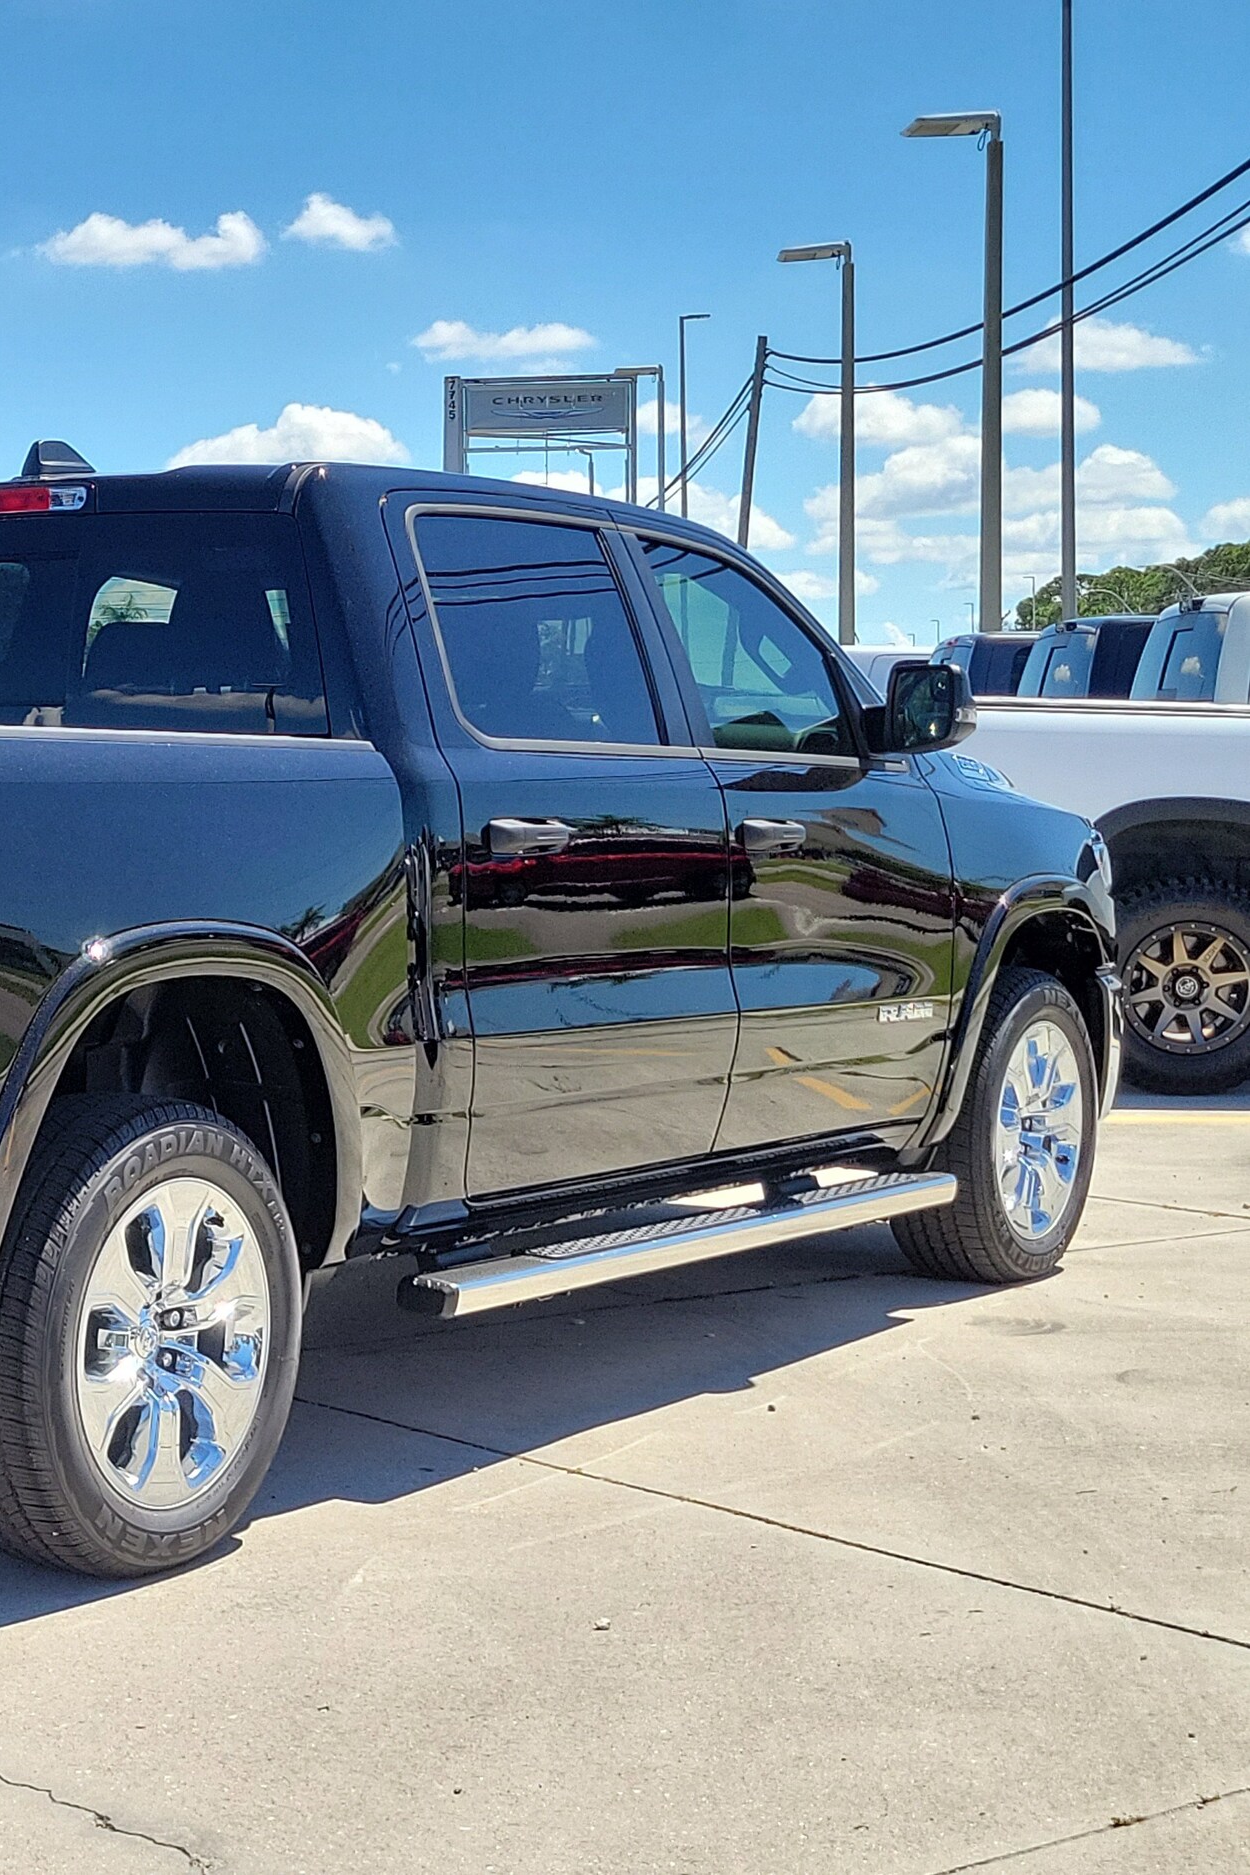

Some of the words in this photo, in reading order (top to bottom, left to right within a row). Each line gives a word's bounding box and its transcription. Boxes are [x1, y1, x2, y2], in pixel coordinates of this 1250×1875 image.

[448, 379, 456, 420] 7745
[492, 394, 603, 406] CHRYSLER
[103, 1129, 224, 1215] ROADIAN
[230, 1143, 274, 1199] HTX
[94, 1503, 228, 1557] NEXEN
